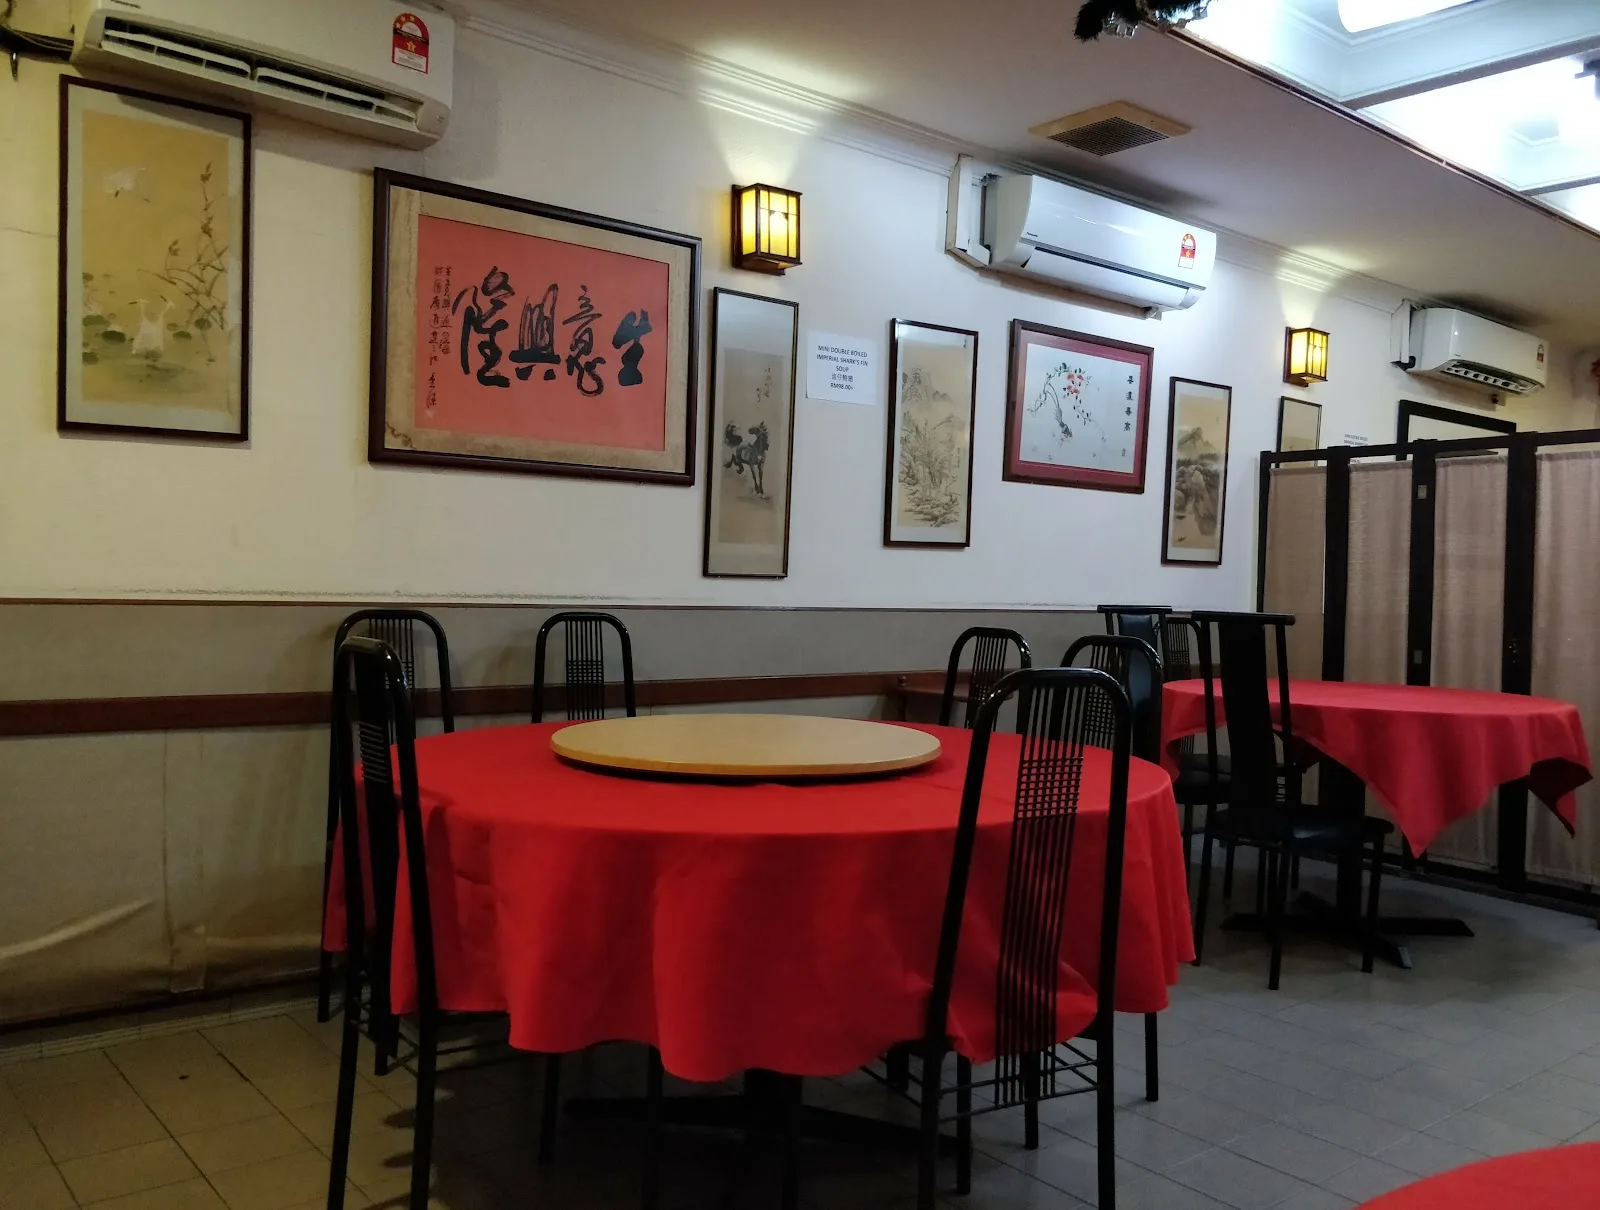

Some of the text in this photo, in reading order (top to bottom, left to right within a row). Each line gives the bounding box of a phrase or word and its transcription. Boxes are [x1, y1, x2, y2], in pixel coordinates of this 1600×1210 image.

[831, 347, 850, 355] DOUBLE
[851, 350, 867, 358] BOILED
[816, 354, 840, 362] IMPERIAL
[840, 357, 860, 366] SHARK'S
